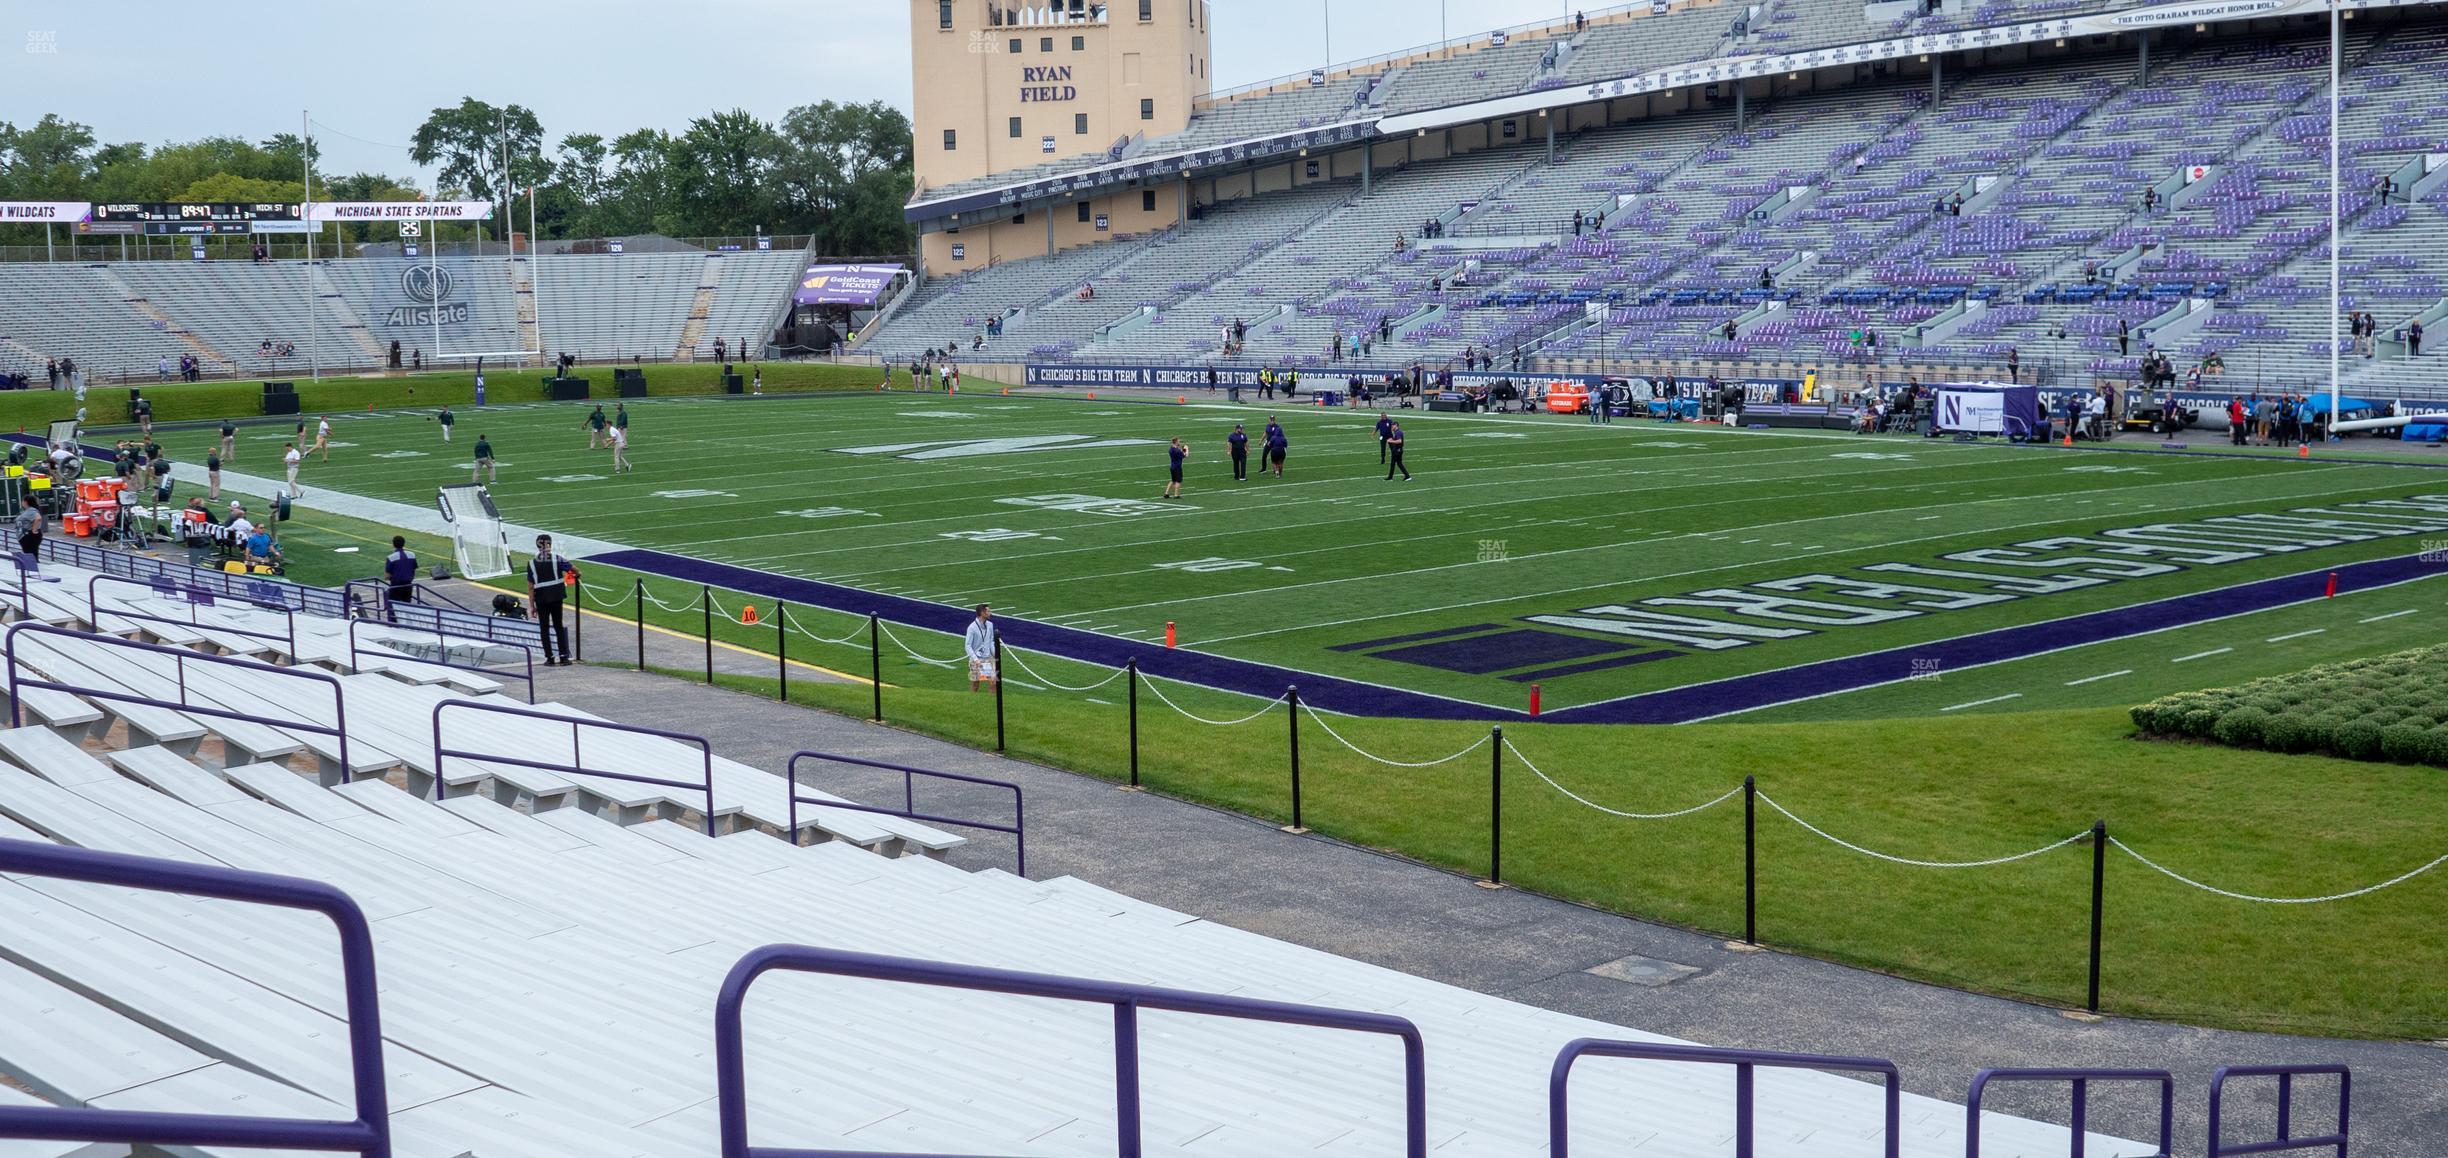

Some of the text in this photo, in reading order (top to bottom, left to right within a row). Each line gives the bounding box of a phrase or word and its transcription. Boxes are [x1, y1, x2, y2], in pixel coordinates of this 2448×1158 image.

[2156, 12, 2189, 20] GRAHAM
[2192, 7, 2225, 16] WILDCAT
[2228, 4, 2255, 13] HONOR
[1023, 66, 1072, 82] RYAN
[1020, 86, 1076, 102] FIELD
[1273, 144, 1284, 153] CITY
[8, 207, 55, 217] WILDCATS
[182, 205, 210, 217] 89:47
[335, 206, 462, 217] MICHIGAN STATE SPARTANS
[402, 222, 417, 235] 25
[388, 306, 467, 325] Allstate
[477, 376, 484, 386] N
[1028, 368, 1035, 381] N
[1041, 369, 1080, 381] CHICAGO'S
[1082, 369, 1095, 381] BIG
[1099, 370, 1113, 381] TEN
[1115, 370, 1137, 382] TEAM
[1143, 369, 1150, 383] N
[1157, 370, 1198, 383] CHICAGO'S
[1234, 372, 1258, 384] TEAM
[1946, 395, 1961, 425] N
[104, 511, 114, 521] G
[744, 611, 755, 621] 10
